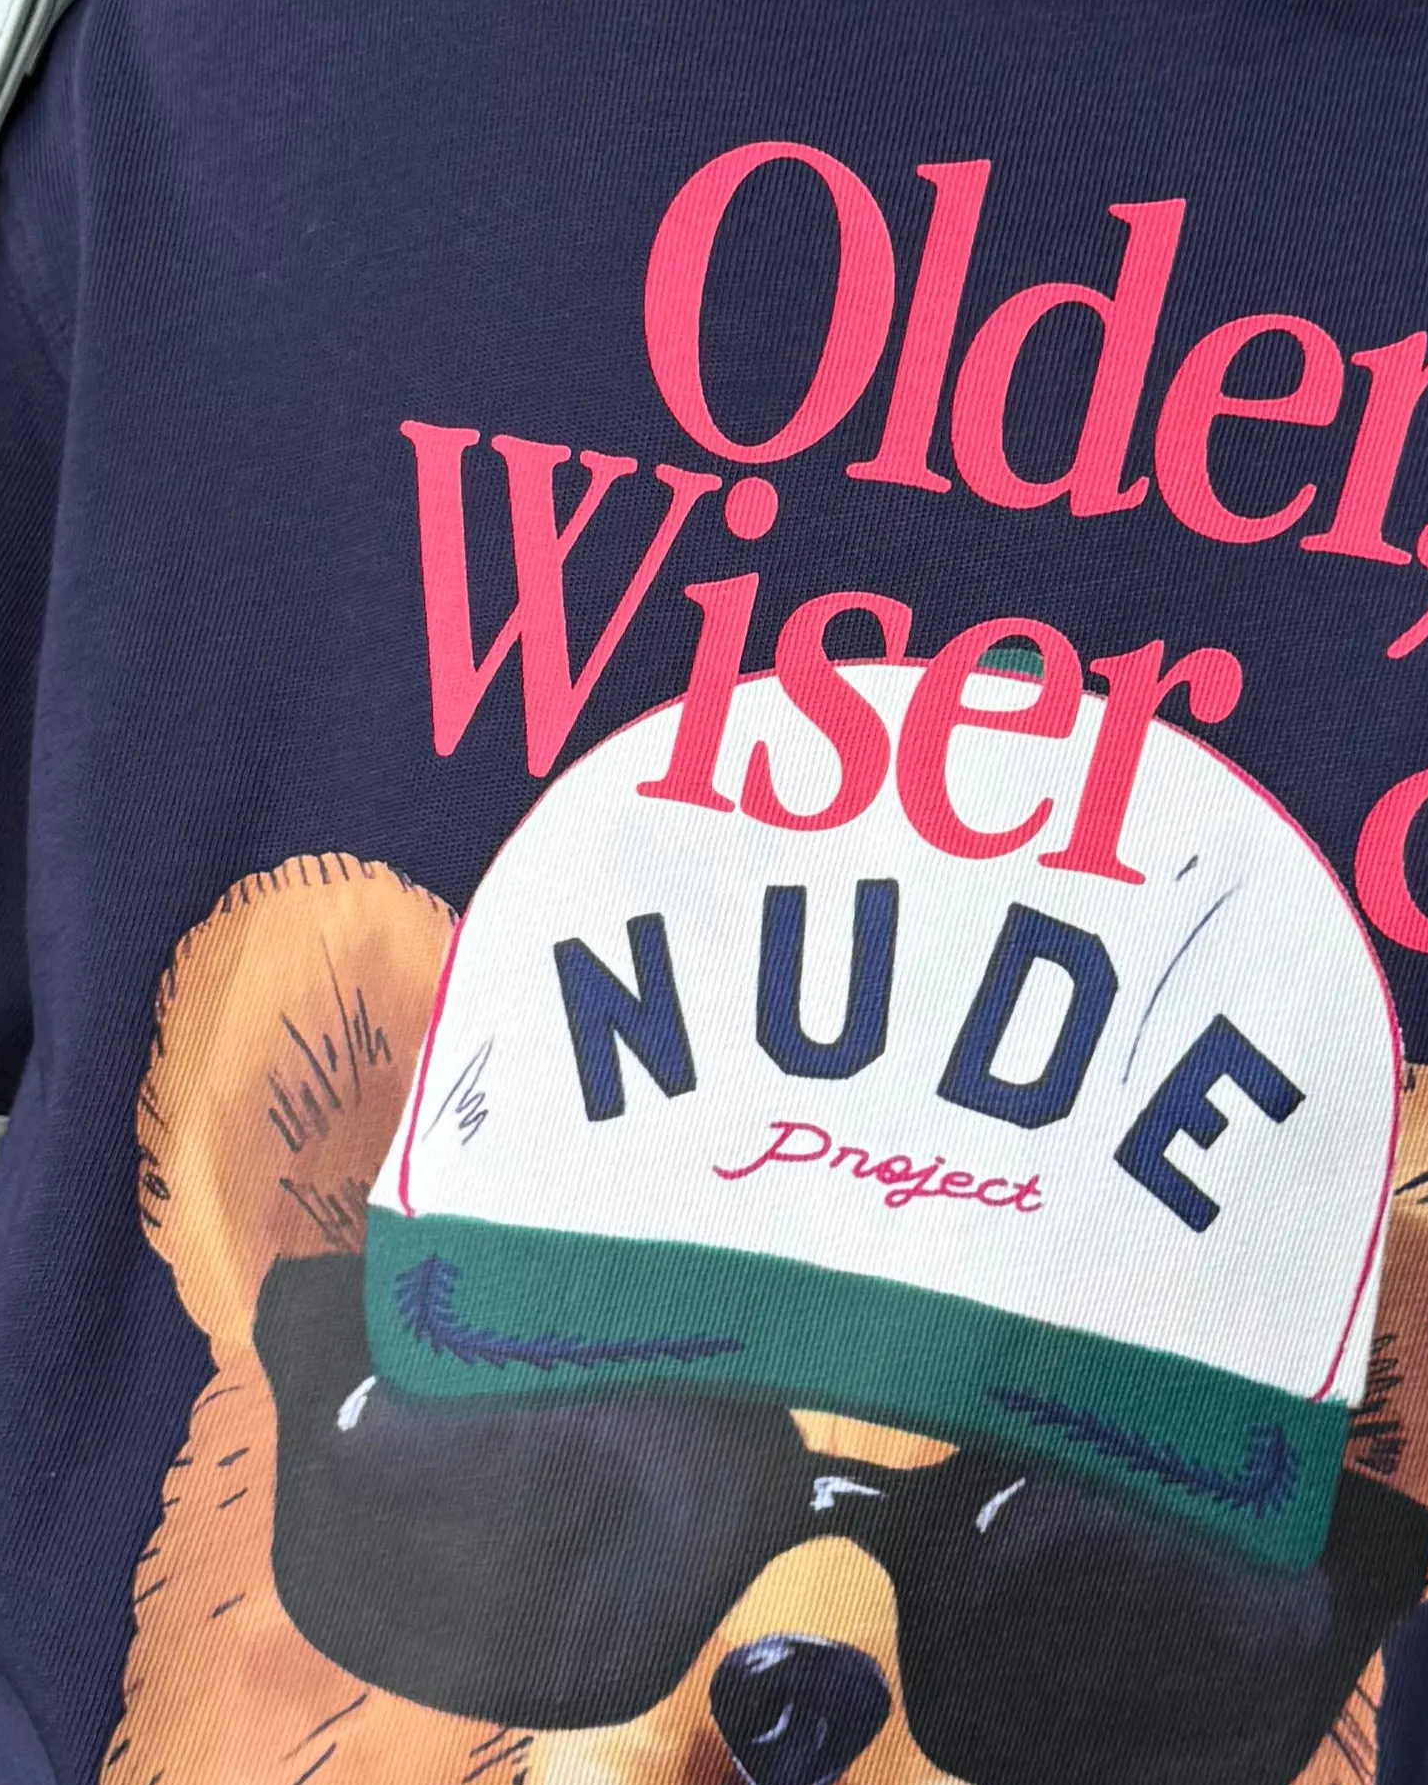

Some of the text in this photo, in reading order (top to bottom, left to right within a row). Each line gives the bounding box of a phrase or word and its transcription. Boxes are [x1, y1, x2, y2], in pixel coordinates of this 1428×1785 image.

[399, 420, 1243, 885] Wiser
[553, 877, 1307, 1235] NUDE
[712, 1120, 1044, 1213] Project
